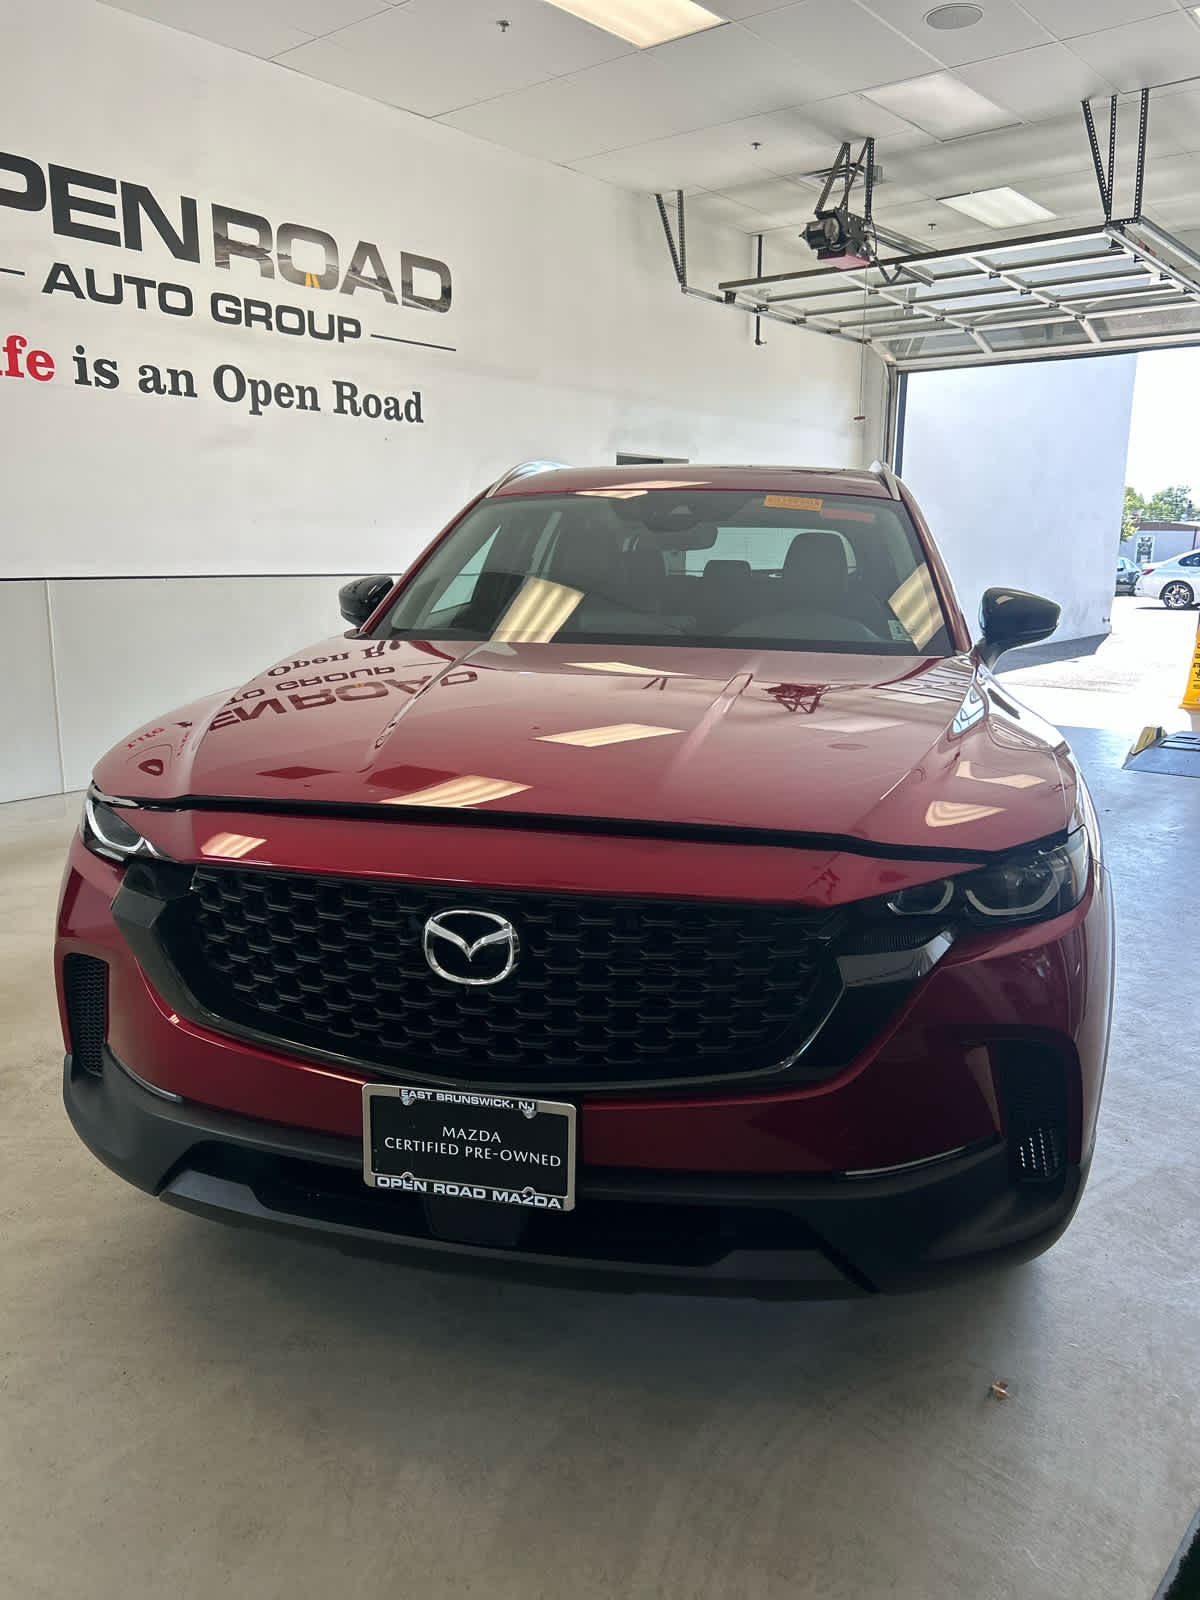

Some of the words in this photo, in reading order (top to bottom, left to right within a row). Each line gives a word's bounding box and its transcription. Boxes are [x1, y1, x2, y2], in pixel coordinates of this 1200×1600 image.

[41, 262, 194, 317] AUTO
[210, 292, 362, 343] GROUP
[0, 334, 55, 382] fe
[72, 345, 119, 389] is
[138, 364, 197, 398] an
[212, 364, 321, 415] Open
[332, 380, 424, 423] Road
[401, 1088, 432, 1101] EAST
[436, 1093, 514, 1109] BRUNSWICK,
[518, 1100, 535, 1111] NJ
[442, 1126, 502, 1143] MAZDA
[384, 1137, 459, 1156] CERTIFIED
[465, 1146, 561, 1167] PRE-OWNED
[377, 1176, 427, 1192] OPEN
[433, 1183, 487, 1200] ROAD
[492, 1191, 562, 1210] MAZDA
